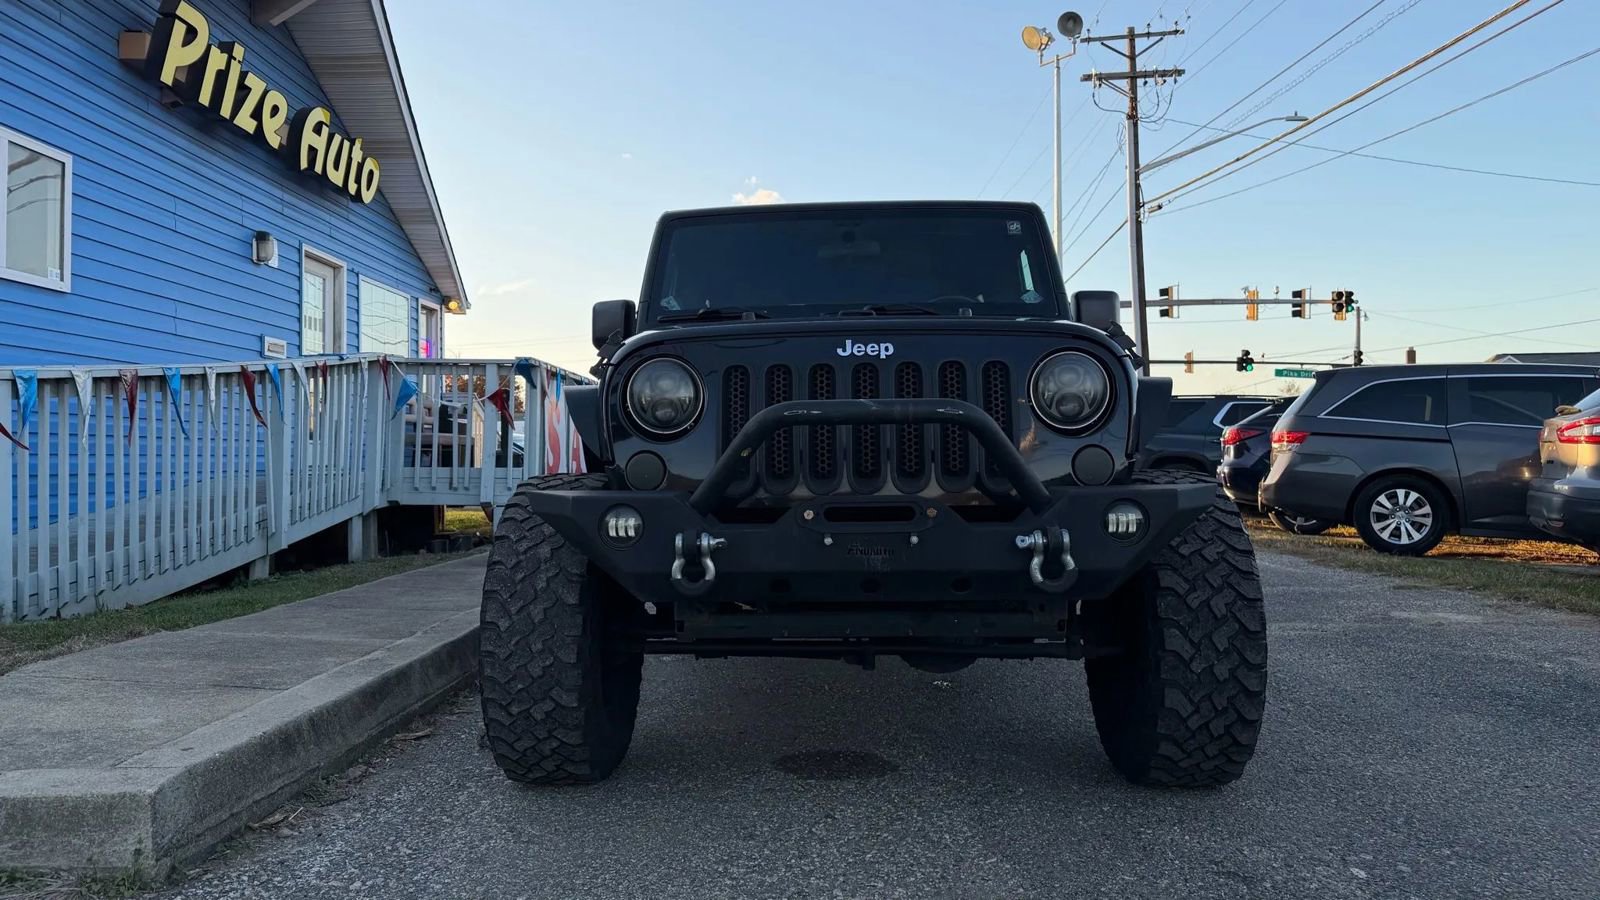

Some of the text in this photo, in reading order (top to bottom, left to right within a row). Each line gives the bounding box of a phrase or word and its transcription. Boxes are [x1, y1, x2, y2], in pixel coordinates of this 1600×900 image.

[160, 0, 380, 204] Prize Auto
[837, 339, 894, 359] Jeep
